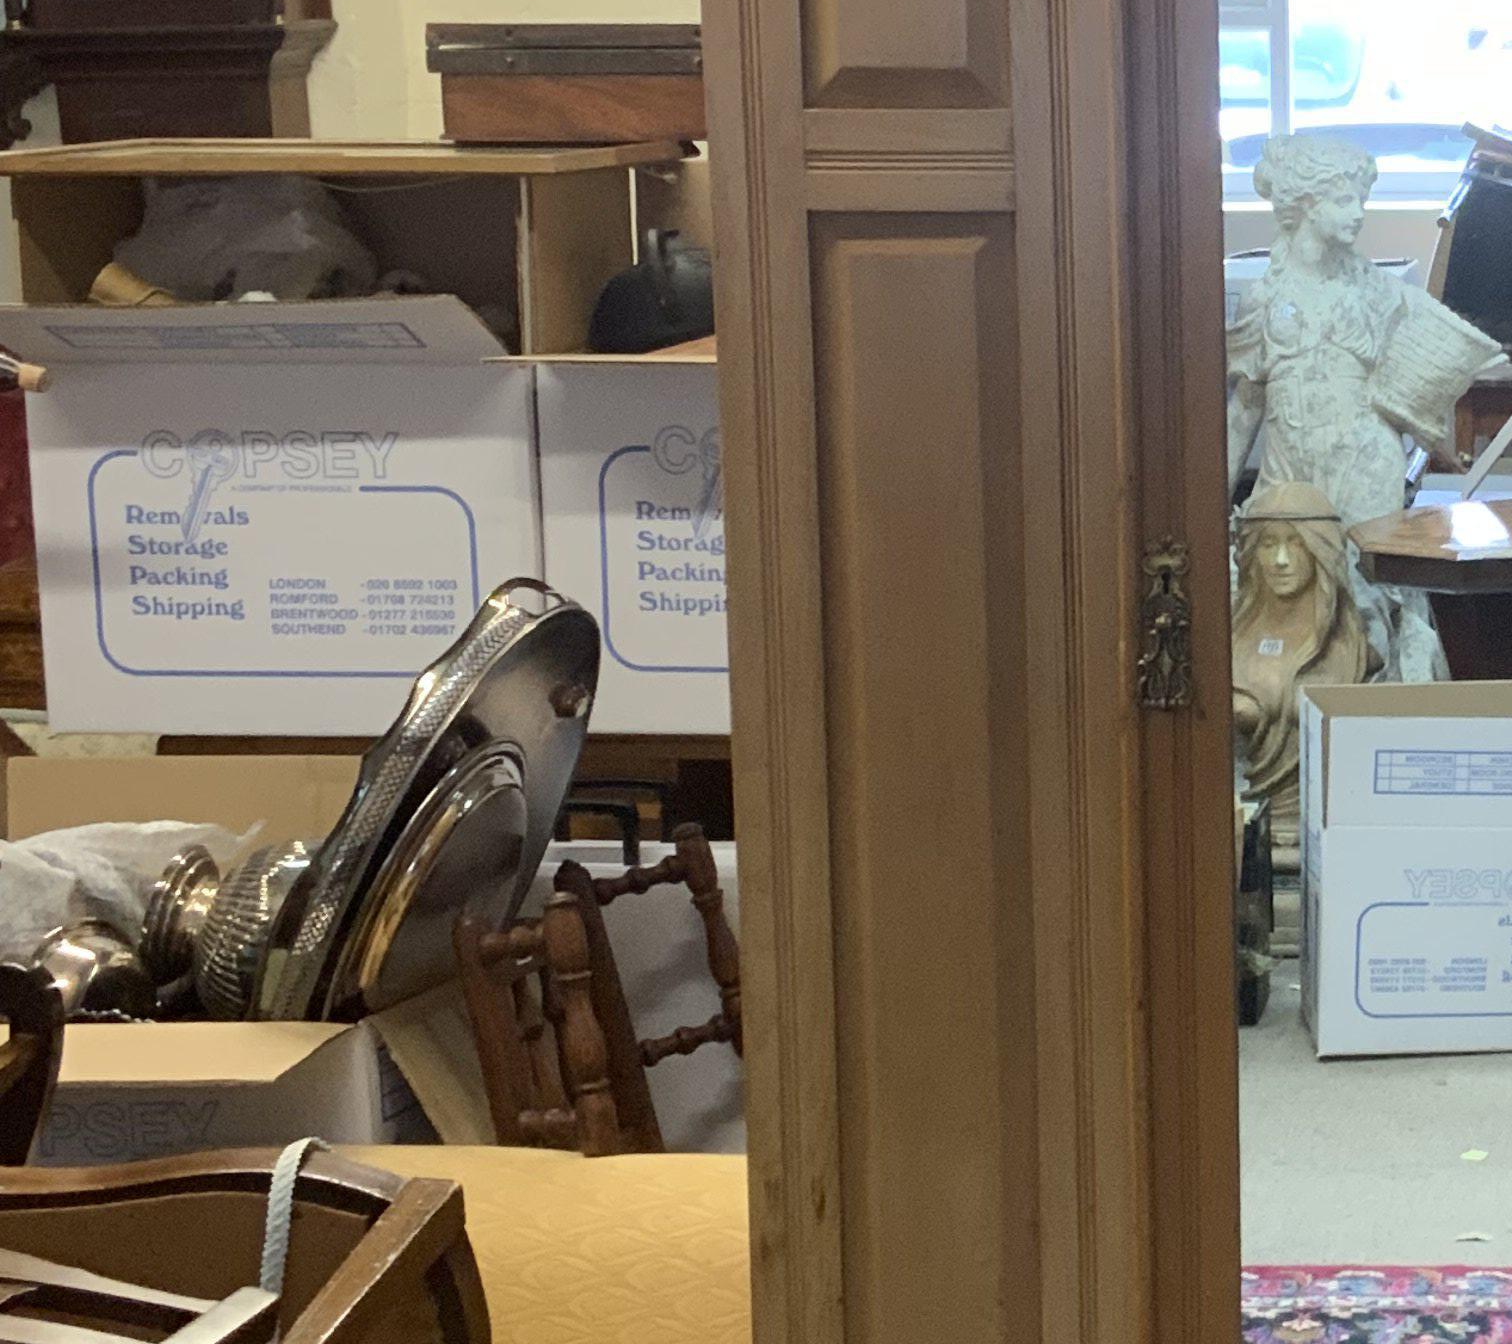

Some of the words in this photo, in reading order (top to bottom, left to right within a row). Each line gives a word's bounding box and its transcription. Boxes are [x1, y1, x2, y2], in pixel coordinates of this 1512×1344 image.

[128, 535, 228, 559] Storage
[129, 566, 229, 590] Packing
[638, 561, 726, 585] Packin
[269, 578, 326, 589] LONDON
[270, 593, 339, 604] ROMFORD
[132, 595, 246, 620] Shipping
[270, 609, 359, 620] BRENTWOOD
[271, 624, 346, 635] SOUTHEND
